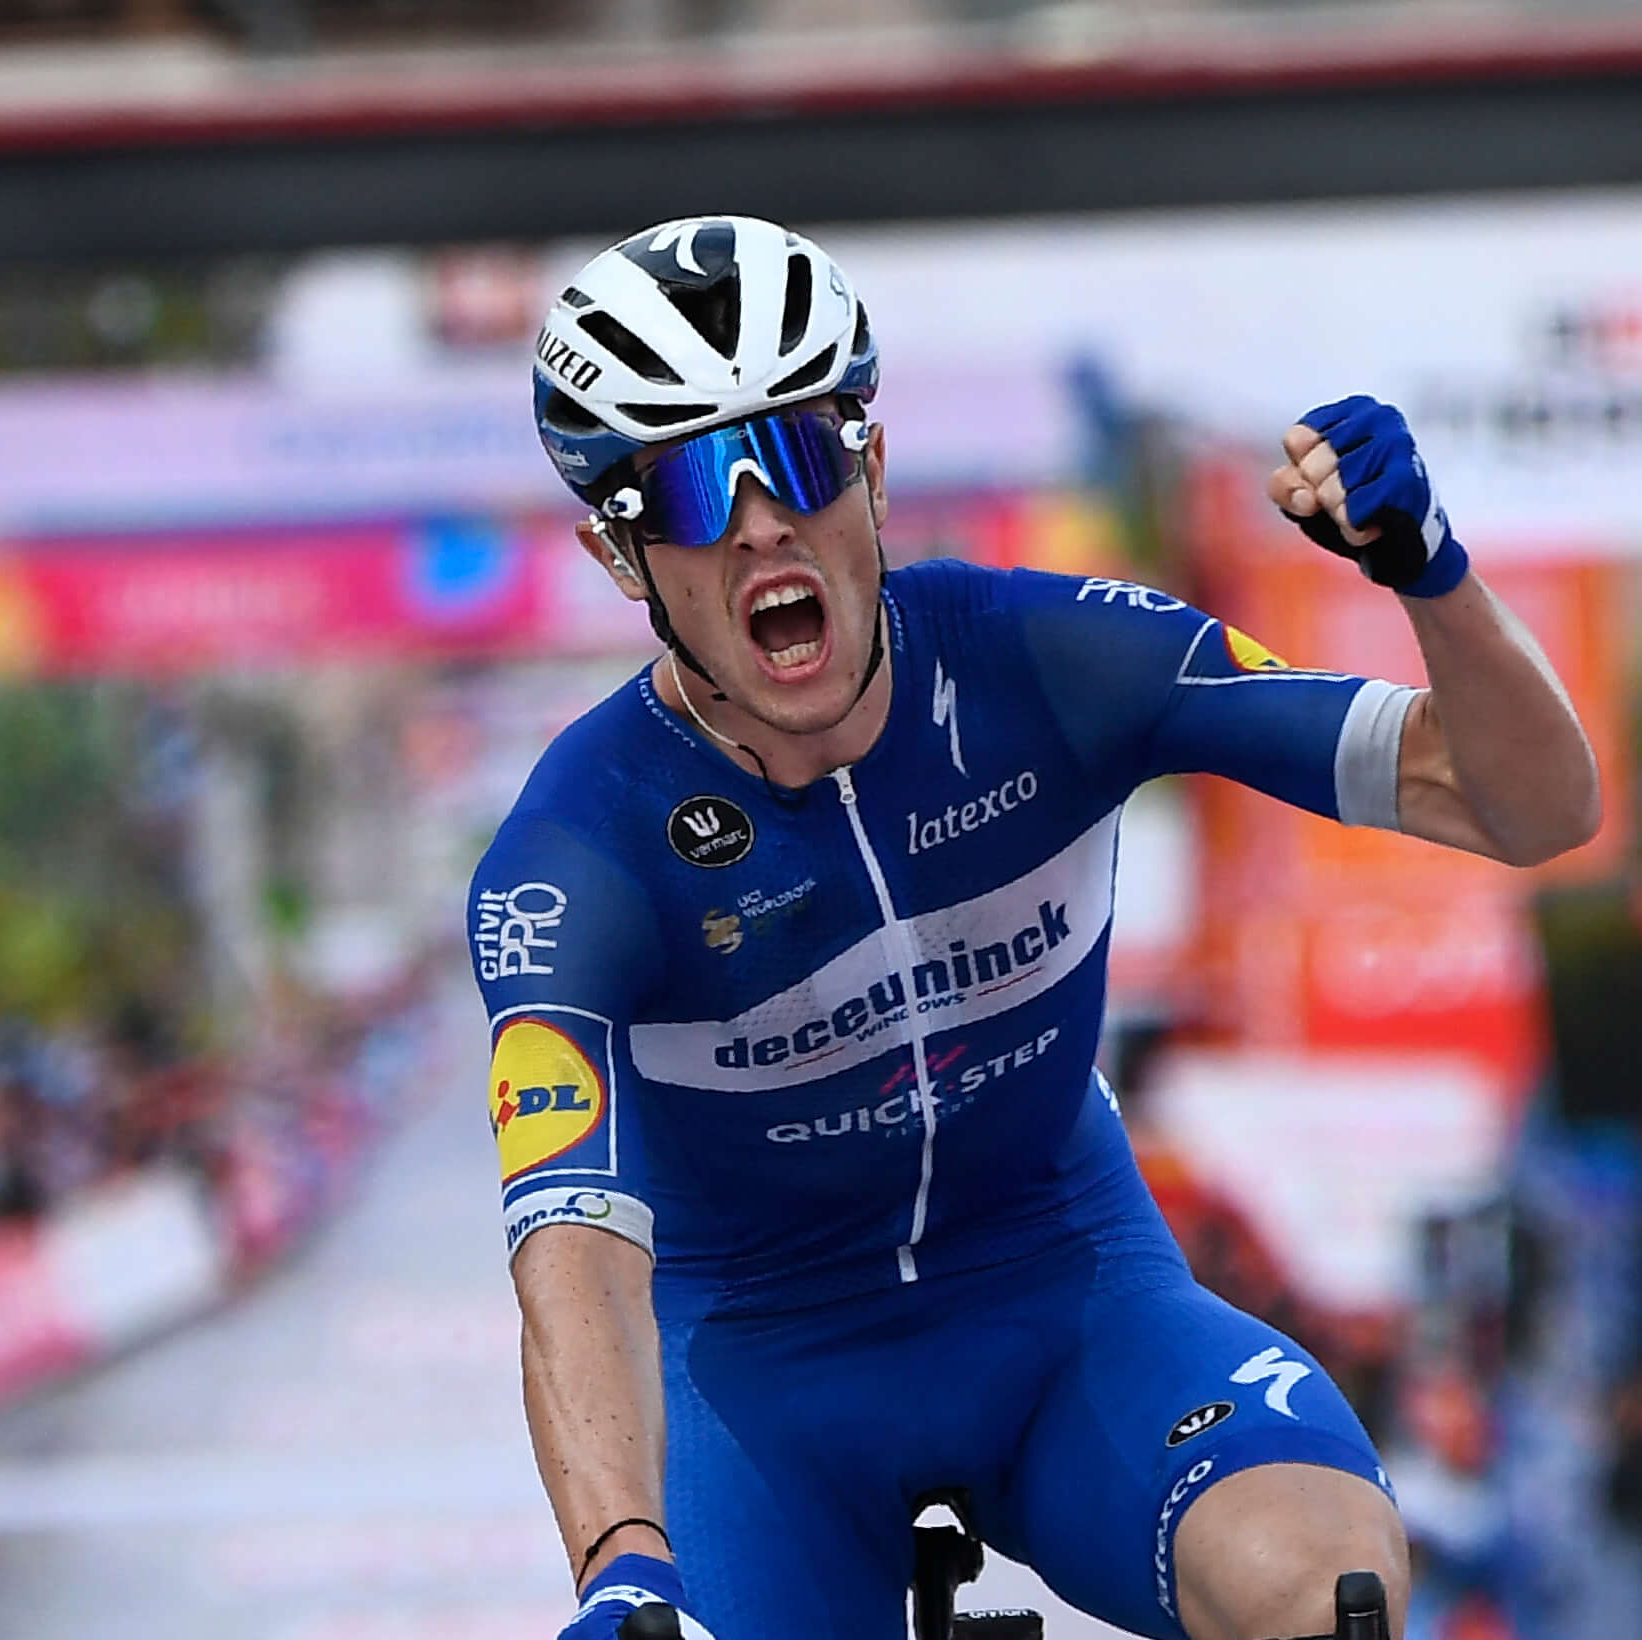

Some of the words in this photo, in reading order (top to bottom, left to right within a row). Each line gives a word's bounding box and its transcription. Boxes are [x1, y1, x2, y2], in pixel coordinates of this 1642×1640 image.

[690, 828, 748, 859] vermarc
[906, 770, 1039, 855] latexco
[475, 887, 508, 982] crivit
[499, 882, 568, 976] PRO
[737, 889, 763, 908] UCI
[714, 900, 1072, 1070] deceuninck
